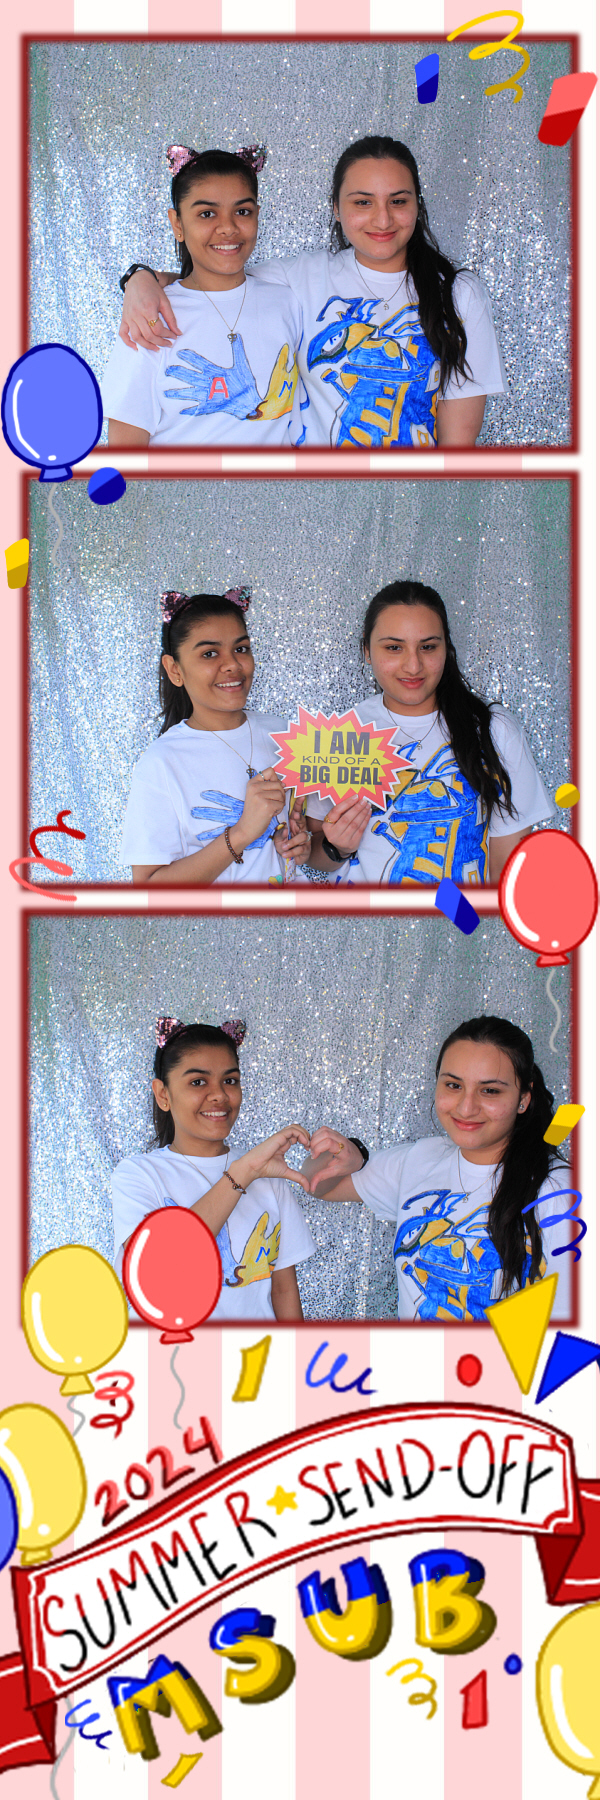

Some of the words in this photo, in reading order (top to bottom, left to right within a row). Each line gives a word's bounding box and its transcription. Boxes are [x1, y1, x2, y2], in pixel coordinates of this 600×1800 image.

[208, 376, 229, 400] A
[313, 730, 321, 754] I
[329, 731, 371, 755] AM
[302, 755, 340, 764] KIND
[344, 756, 367, 765] OF
[370, 757, 381, 766] A
[299, 764, 331, 784] BIG
[336, 766, 383, 786] DEAL
